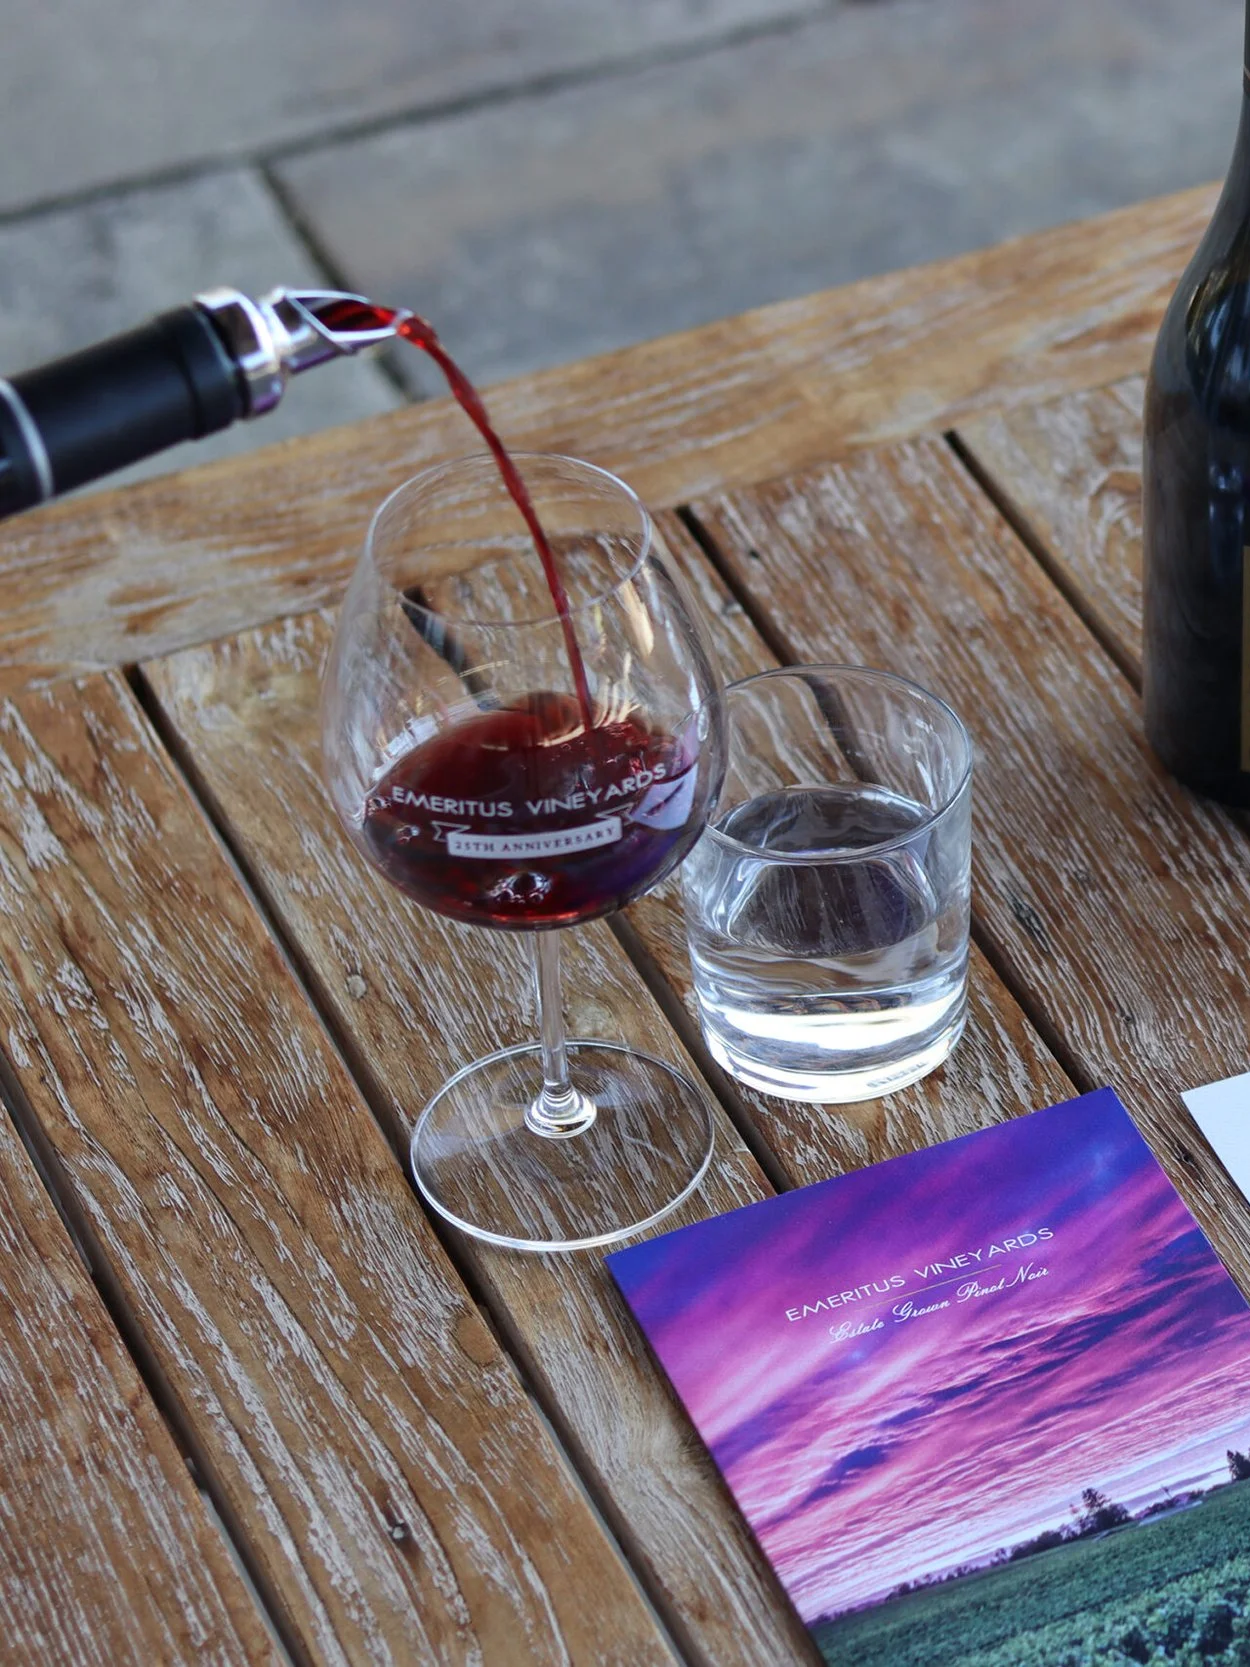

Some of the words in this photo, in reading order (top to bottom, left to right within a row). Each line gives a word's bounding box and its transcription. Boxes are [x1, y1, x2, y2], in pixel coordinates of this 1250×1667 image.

[392, 785, 513, 818] EMERITUS
[525, 762, 667, 815] VINEYARDS
[455, 840, 495, 853] 25TH
[502, 827, 616, 853] ANNIVERSARY
[785, 1274, 906, 1322] EMERITUS
[913, 1226, 1054, 1280] VINEYARDS
[829, 1320, 885, 1344] Estate
[892, 1300, 951, 1323] Grown
[956, 1279, 1005, 1304] Pinot
[1005, 1262, 1050, 1288] Noir
